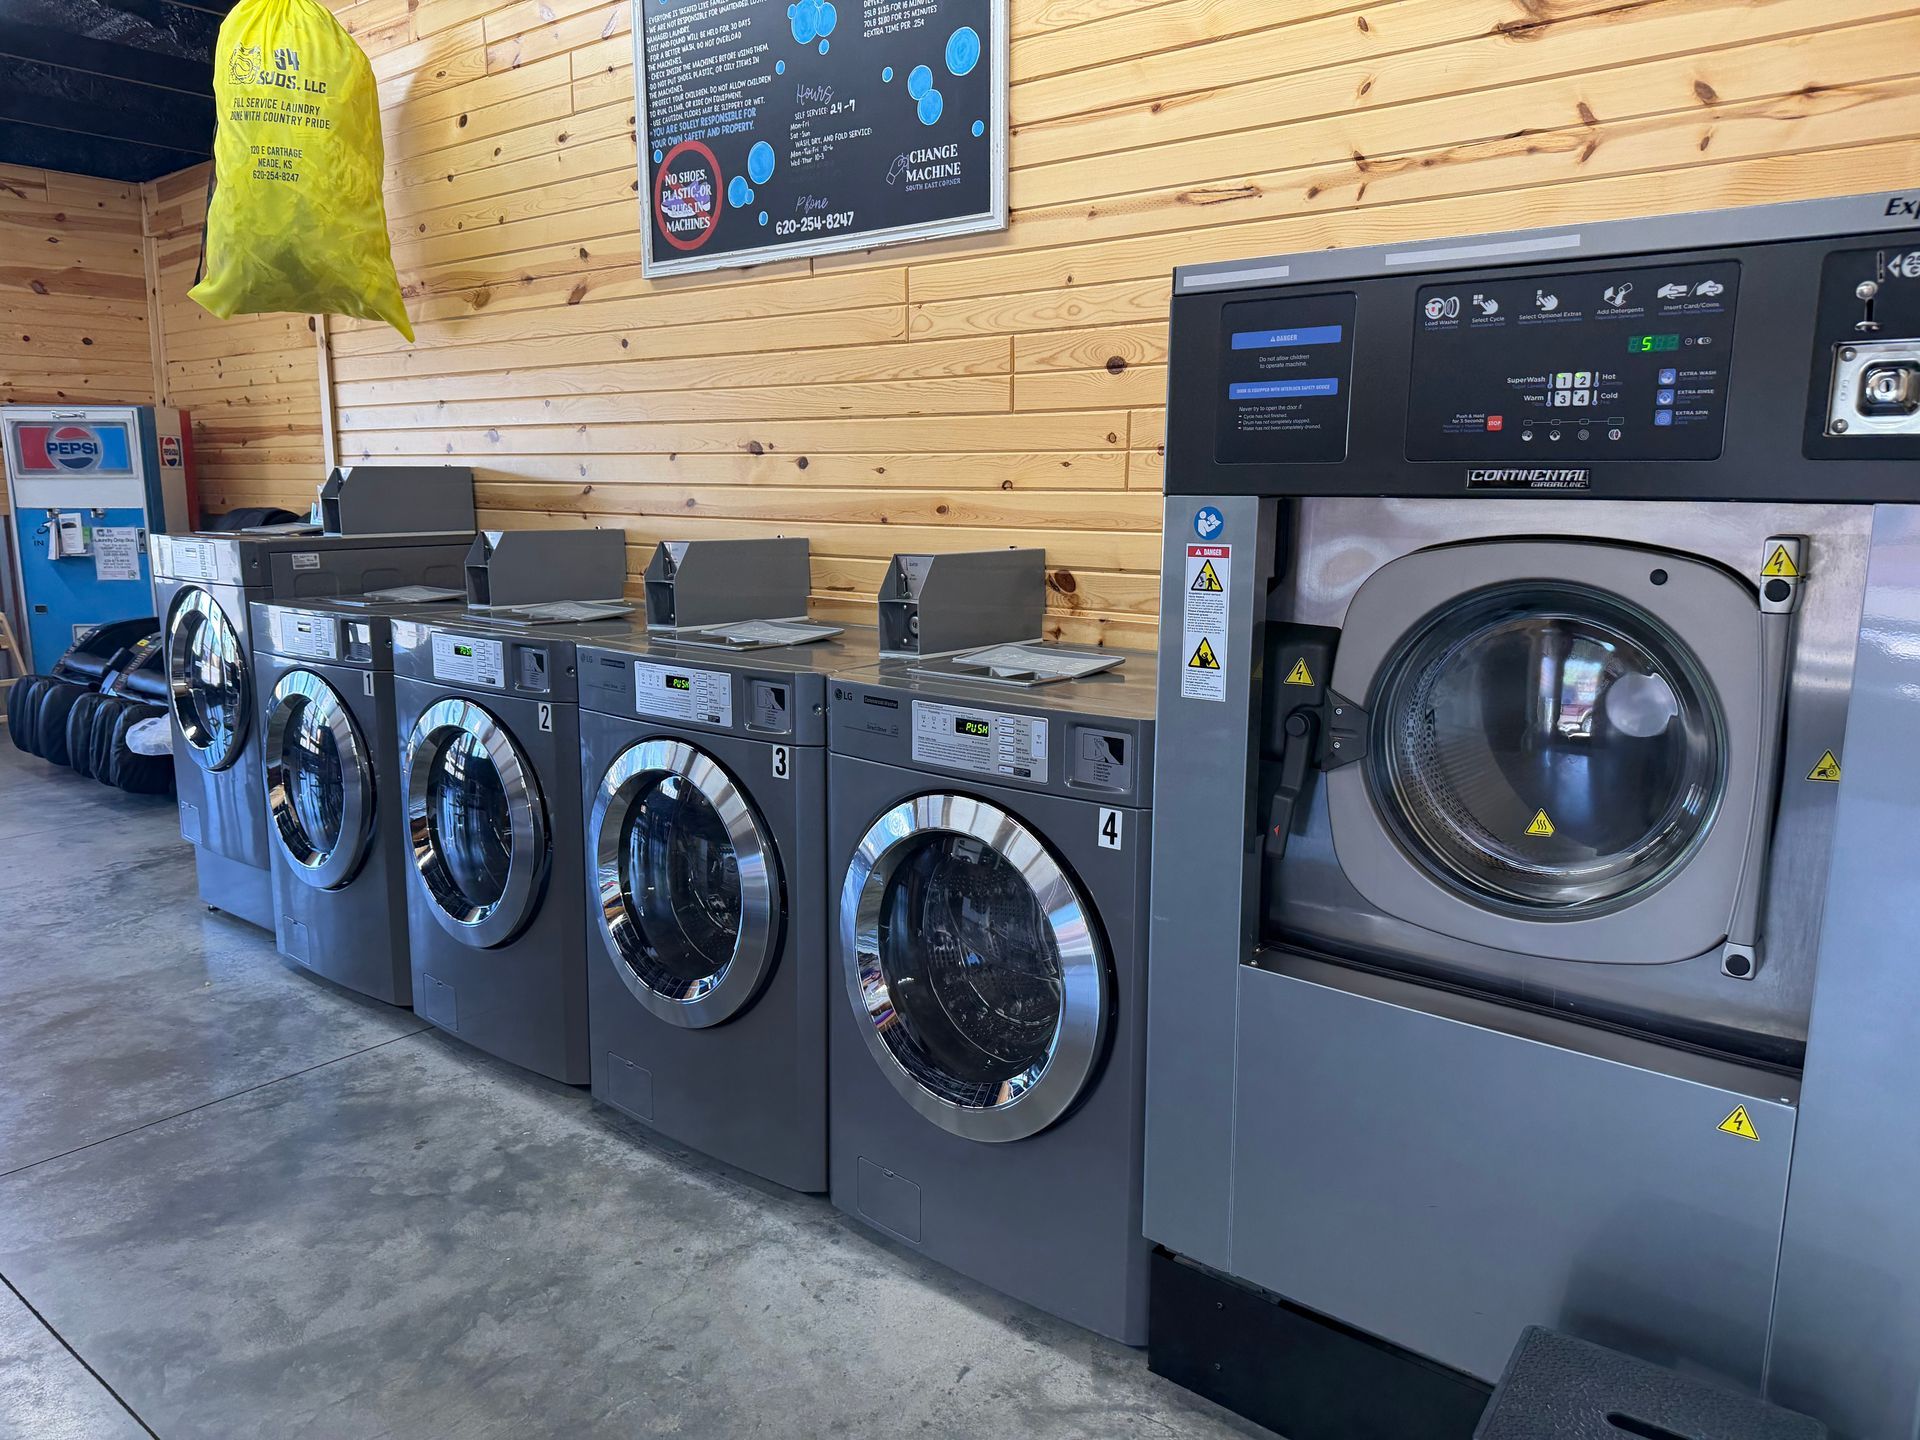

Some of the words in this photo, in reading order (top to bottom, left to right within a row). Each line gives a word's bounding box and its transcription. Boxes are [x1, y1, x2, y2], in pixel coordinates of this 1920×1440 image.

[890, 2, 901, 11] FOR
[891, 13, 902, 21] FOR
[911, 5, 937, 17] MINUTES
[660, 41, 670, 49] AND
[671, 36, 686, 47] FOUND
[687, 32, 699, 41] WILL
[700, 30, 706, 38] BE
[707, 28, 718, 36] HELD
[720, 24, 730, 33] FOR
[731, 22, 737, 30] 30
[738, 18, 751, 28] DAYS
[885, 23, 899, 33] TIME
[901, 21, 911, 30] PER
[274, 48, 300, 71] 54
[304, 79, 327, 94] LLC
[652, 98, 671, 107] PROTECT
[718, 84, 728, 92] NOT
[729, 80, 746, 90] ALLOW
[747, 75, 771, 87] CHILDREN
[796, 84, 834, 105] Hours
[246, 98, 278, 109] SERVICE
[281, 101, 320, 116] LAUNDRY
[684, 109, 701, 119] FLOORS
[702, 106, 712, 114] MAY
[714, 104, 720, 112] BE
[721, 100, 743, 111] SLIPPERY
[745, 99, 752, 107] OR
[753, 96, 765, 105] WET.
[244, 111, 260, 121] WITH
[263, 112, 303, 126] COUNTRY
[305, 117, 330, 130] PRIDE
[653, 127, 664, 137] YOU
[666, 123, 677, 133] ARE
[679, 119, 700, 131] SOLELY
[700, 111, 742, 126] RESPONSIBLE
[743, 107, 756, 118] FOR
[795, 111, 805, 120] SELF
[651, 138, 666, 149] YOUR
[668, 134, 683, 145] OWN
[684, 130, 706, 142] SAFETY
[707, 127, 720, 137] AND
[722, 121, 754, 135] PROPERTY.
[835, 132, 848, 140] FOLD
[262, 146, 265, 154] E
[267, 146, 302, 158] CARTHAGE
[909, 143, 958, 164] CHANGE
[284, 160, 292, 169] KS
[253, 170, 299, 182] 620-254-8247
[906, 162, 961, 183] MACHINE
[665, 174, 677, 186] NO
[906, 183, 923, 192] SOUTH
[924, 181, 938, 190] EAST
[938, 178, 961, 188] CORNER
[700, 185, 712, 196] OR
[672, 203, 693, 213] RUGS
[694, 201, 704, 212] IN
[666, 216, 710, 233] MACHINES
[776, 211, 854, 235] 620-254-8247
[1538, 312, 1562, 320] Optional
[1276, 334, 1298, 342] DANGER
[1561, 377, 1566, 386] 1
[1579, 376, 1586, 385] 2
[1560, 395, 1566, 404] 3
[1577, 394, 1585, 404] 4
[46, 442, 98, 455] PEPSI
[1471, 469, 1587, 481] CONTINENTAL
[586, 655, 592, 663] LG
[366, 674, 371, 694] 1
[673, 678, 689, 689] PUSH
[844, 691, 852, 700] LG
[541, 705, 549, 729] 2
[966, 722, 988, 734] PUSH
[775, 748, 786, 776] 3
[1103, 812, 1118, 845] 4
